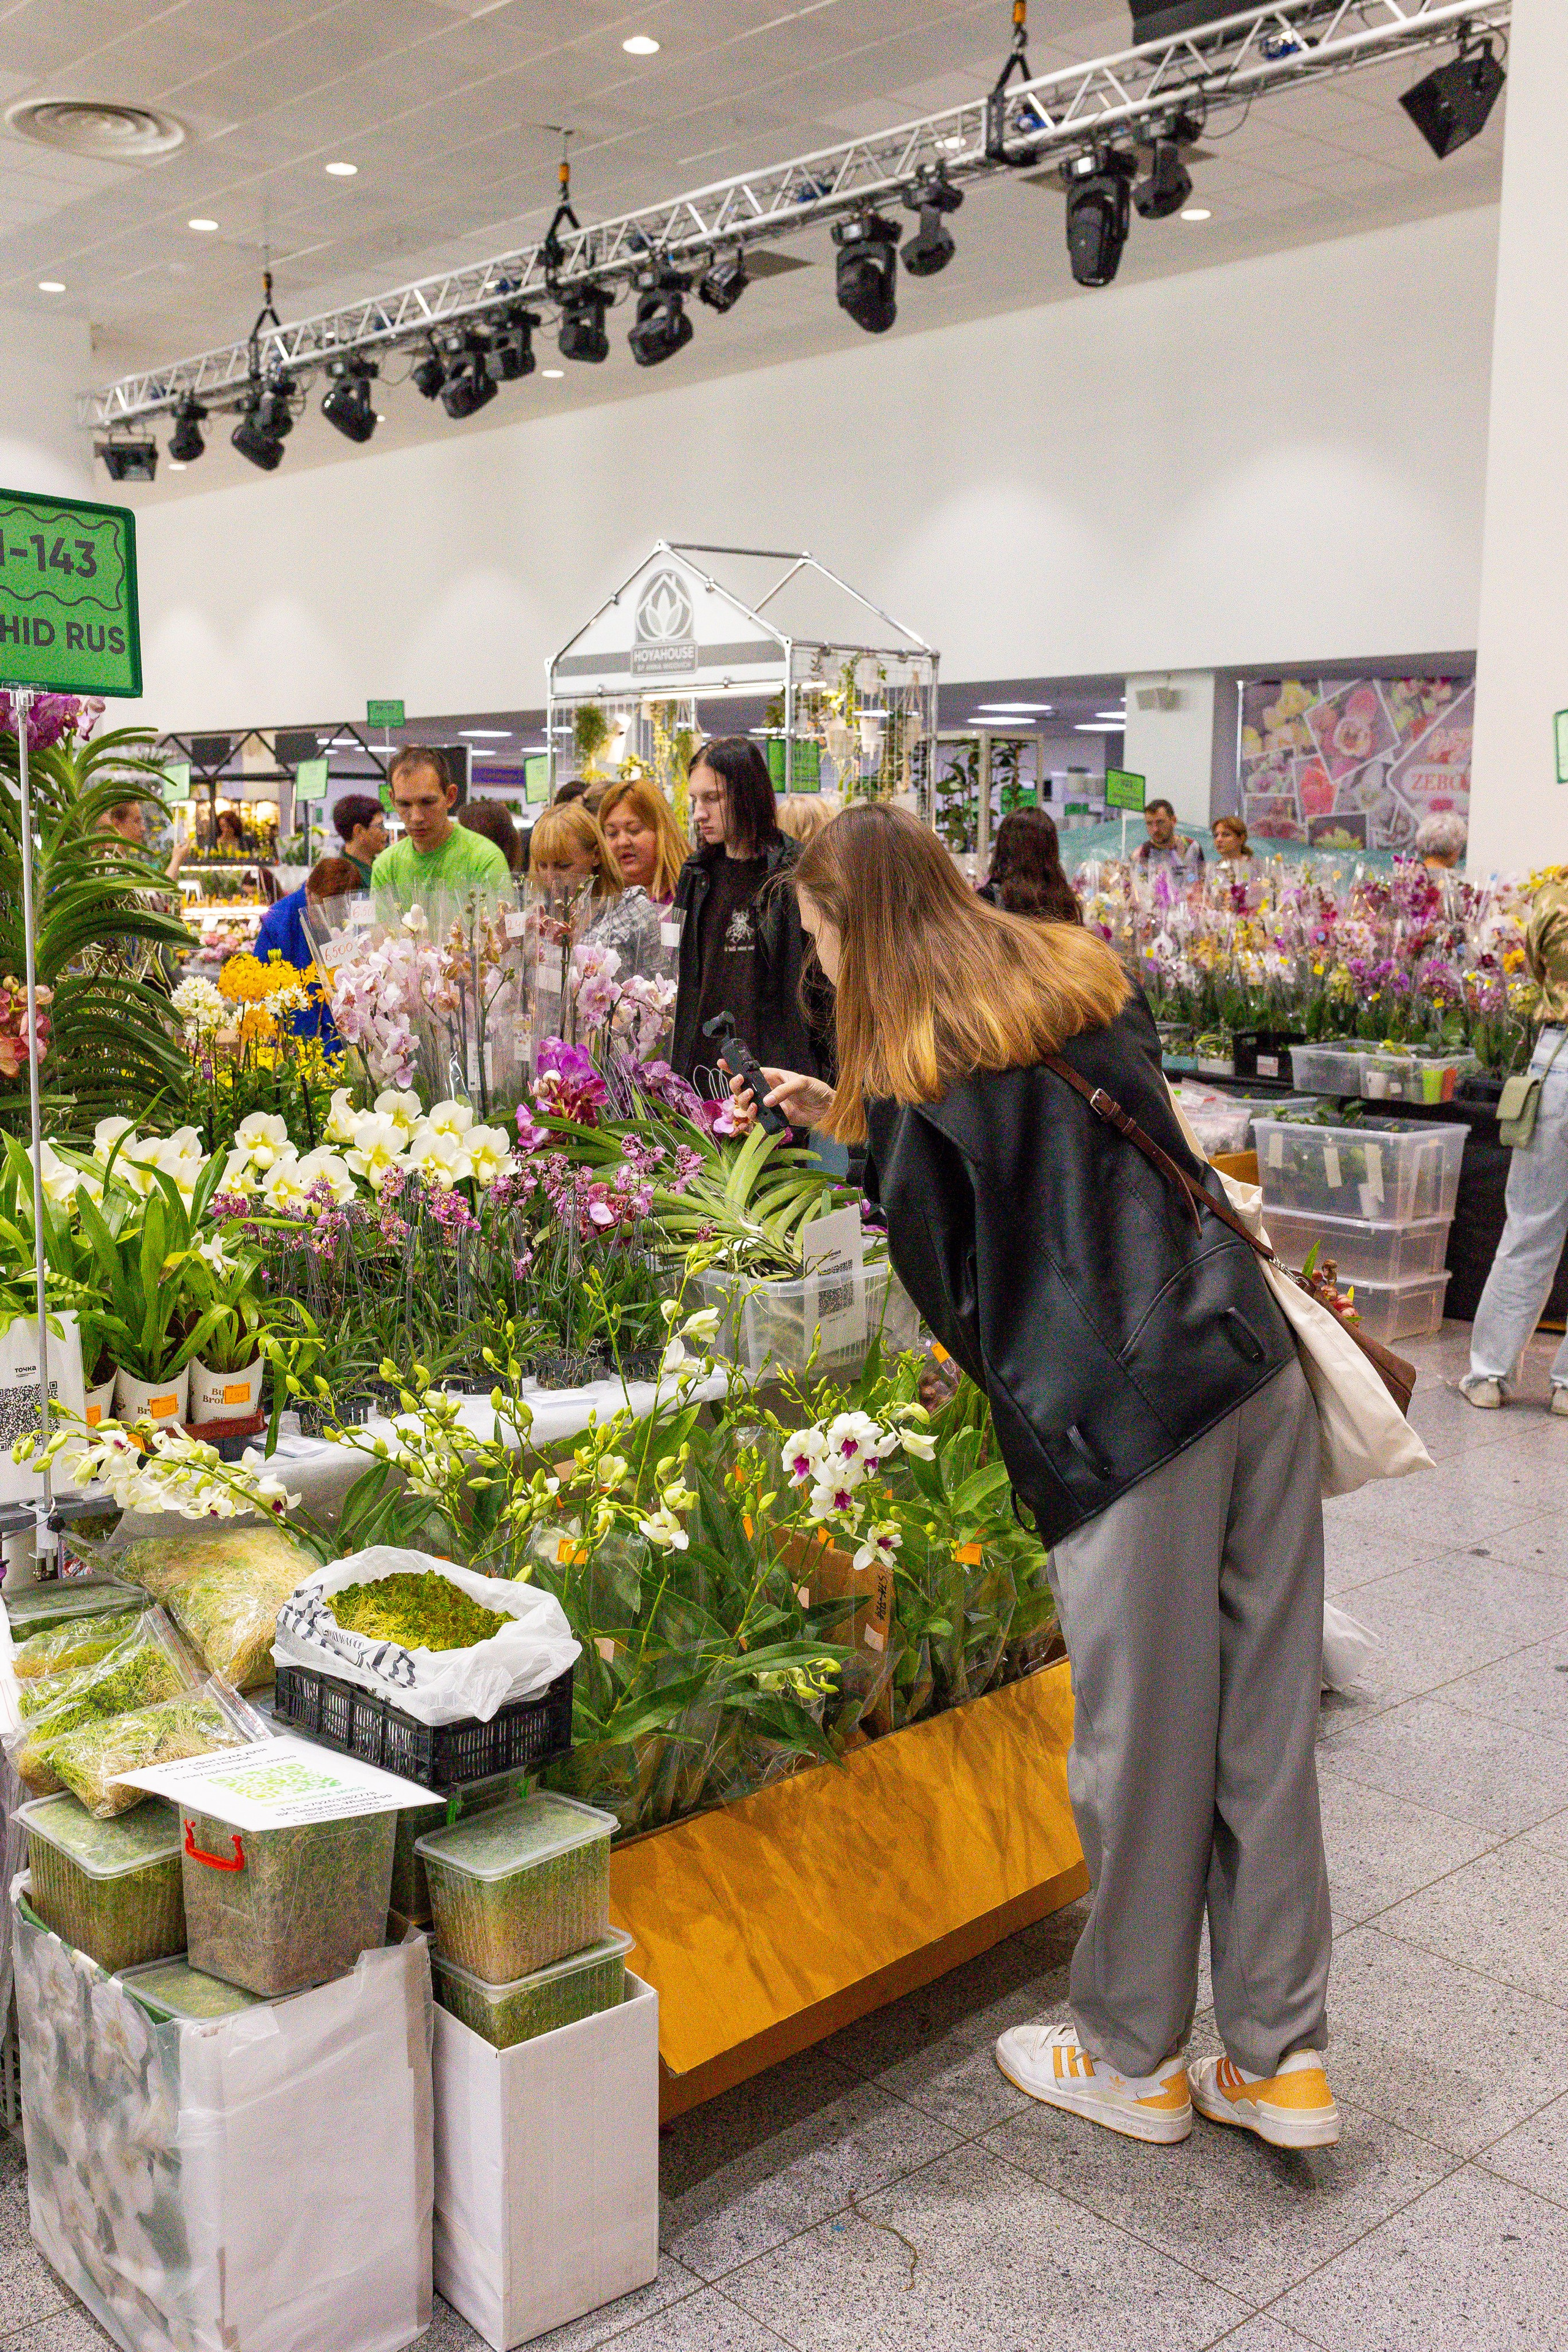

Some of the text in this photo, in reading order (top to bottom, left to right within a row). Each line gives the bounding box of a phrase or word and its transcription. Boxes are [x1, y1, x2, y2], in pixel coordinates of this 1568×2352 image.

[66, 621, 125, 654] RUS
[634, 646, 695, 662] HOYAHOUSE
[325, 942, 353, 962] 6500
[203, 1395, 225, 1404] Brot
[212, 1388, 225, 1397] Bu
[188, 1754, 242, 1766] сфагнум
[193, 1756, 252, 1770] растений
